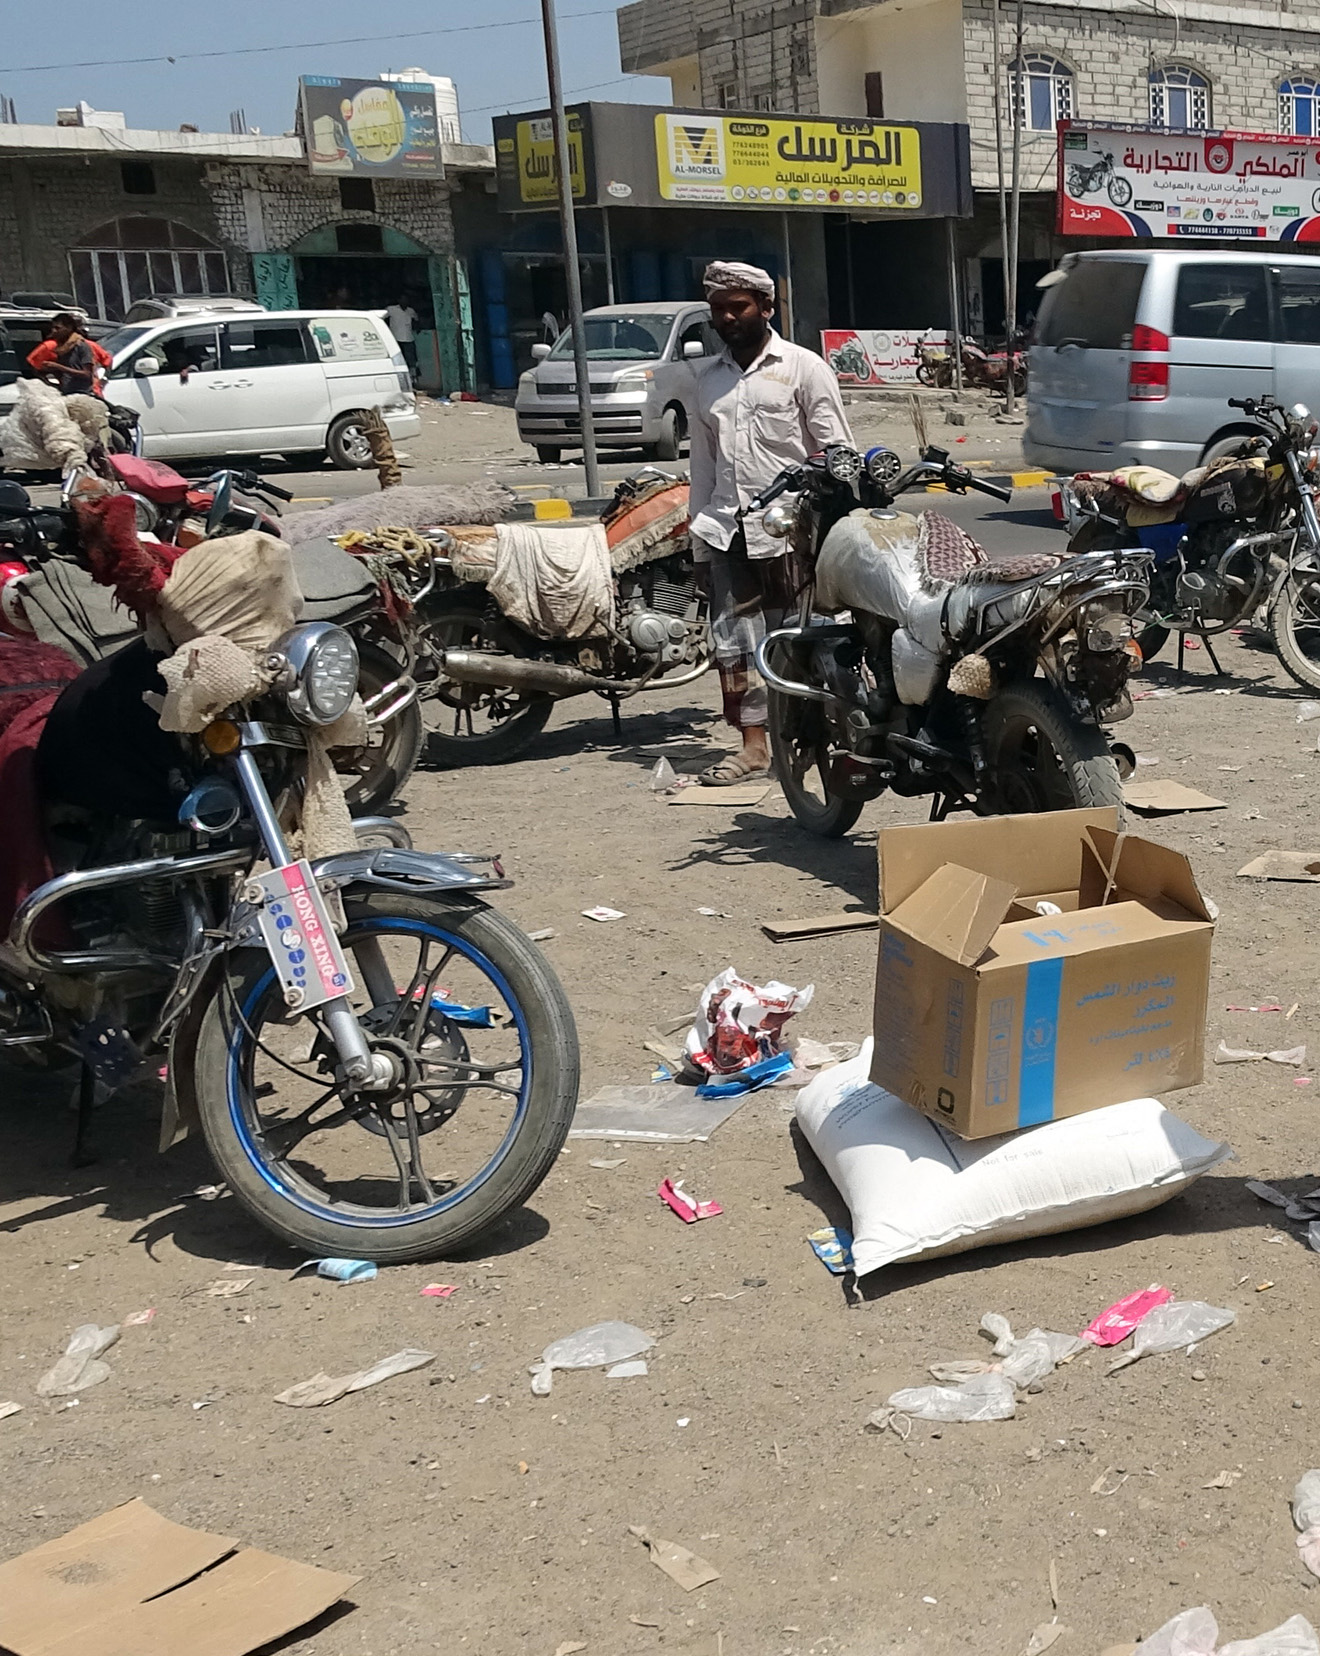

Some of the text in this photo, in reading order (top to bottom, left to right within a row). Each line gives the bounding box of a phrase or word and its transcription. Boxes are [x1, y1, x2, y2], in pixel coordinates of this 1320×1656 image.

[841, 123, 870, 135] شركة
[777, 126, 902, 172] المرسل
[675, 165, 722, 175] AL-MORSEL
[1123, 147, 1305, 184] الملكي التجارية
[775, 170, 907, 187] للصرافة والتحويلات المالية
[1197, 182, 1222, 193] النارية
[1070, 208, 1102, 220] تجزئة
[309, 934, 336, 977] XING
